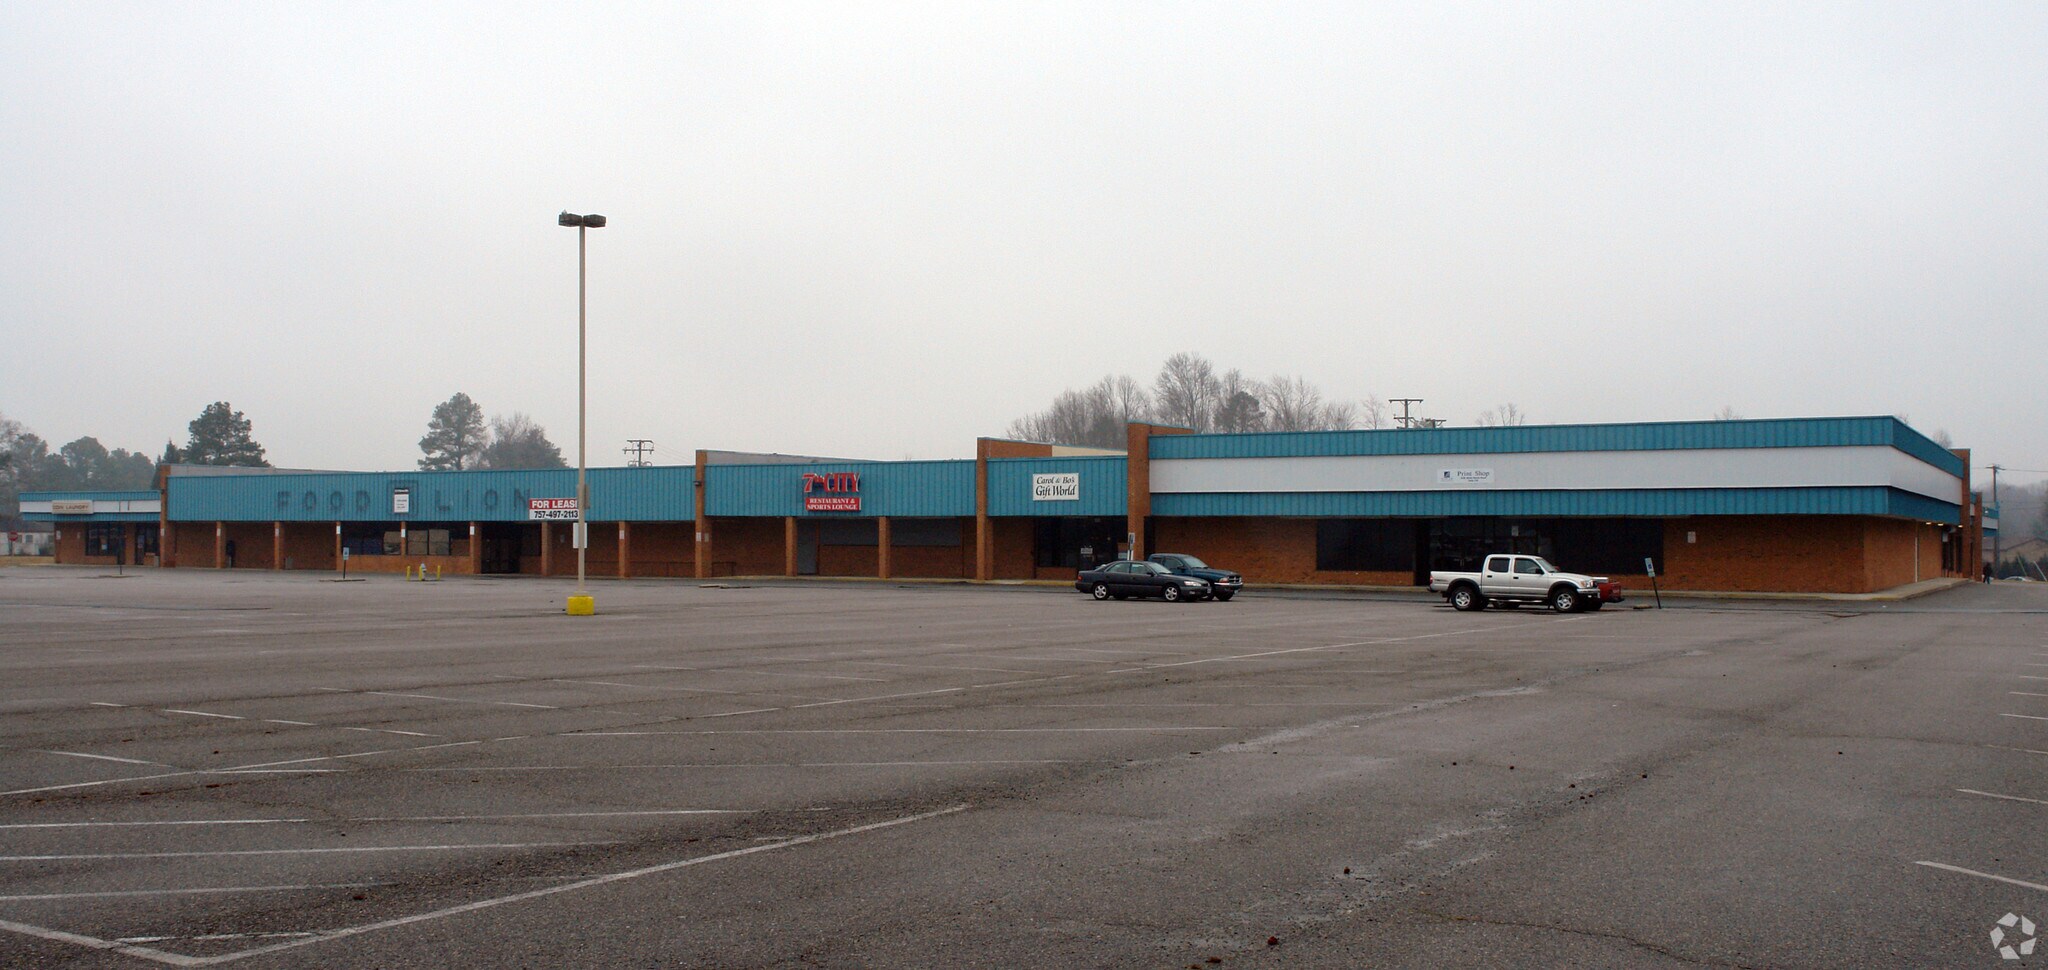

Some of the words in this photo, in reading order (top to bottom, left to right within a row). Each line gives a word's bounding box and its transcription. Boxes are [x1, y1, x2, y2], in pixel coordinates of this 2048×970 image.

[824, 472, 860, 492] CITY
[1036, 485, 1051, 498] Gift
[1053, 485, 1076, 496] World
[277, 490, 370, 512] FOOD
[435, 488, 530, 512] LION
[532, 500, 550, 508] FOR
[534, 510, 578, 518] 757-497-2113
